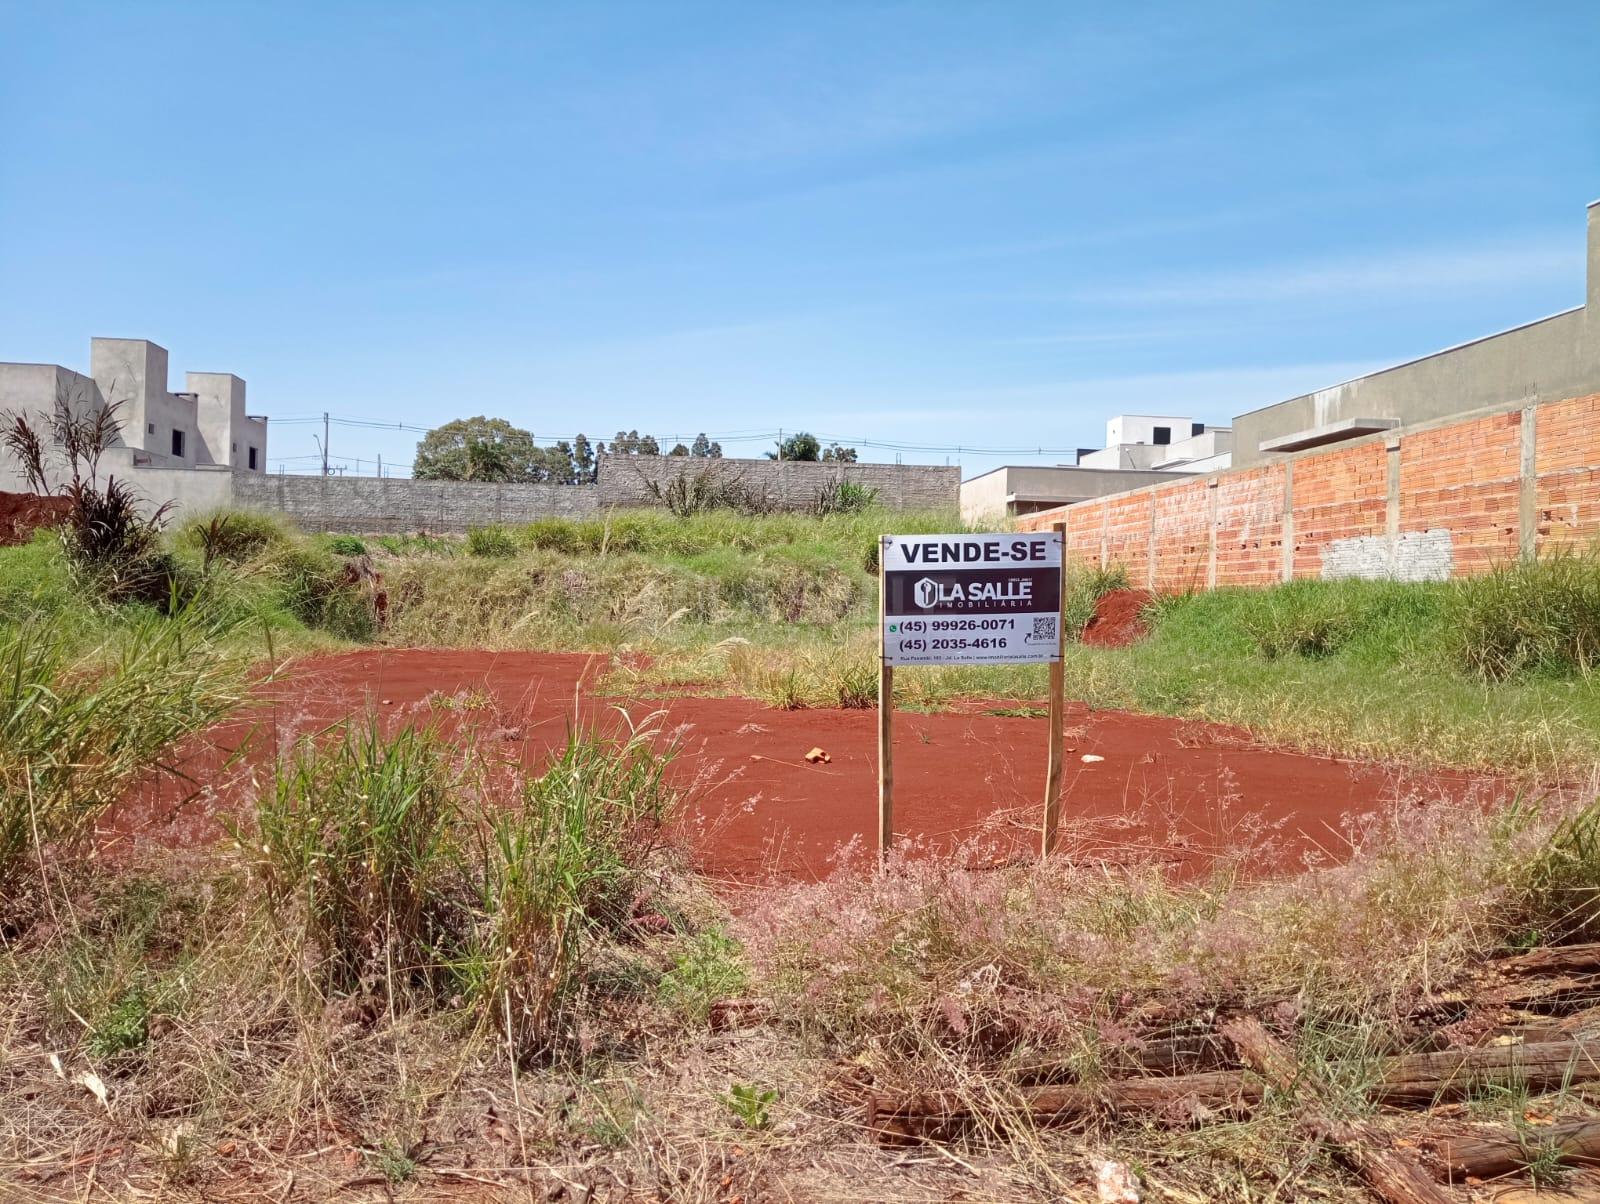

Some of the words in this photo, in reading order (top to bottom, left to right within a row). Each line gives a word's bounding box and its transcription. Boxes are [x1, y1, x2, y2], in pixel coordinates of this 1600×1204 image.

[901, 541, 1047, 563] VENDE-SE
[939, 583, 965, 600] LA
[968, 582, 1032, 600] SALLE
[899, 621, 927, 633] (45)
[932, 619, 1015, 631] 99926-0071
[899, 639, 927, 651] (45)
[932, 638, 1007, 649] 2035-4616
